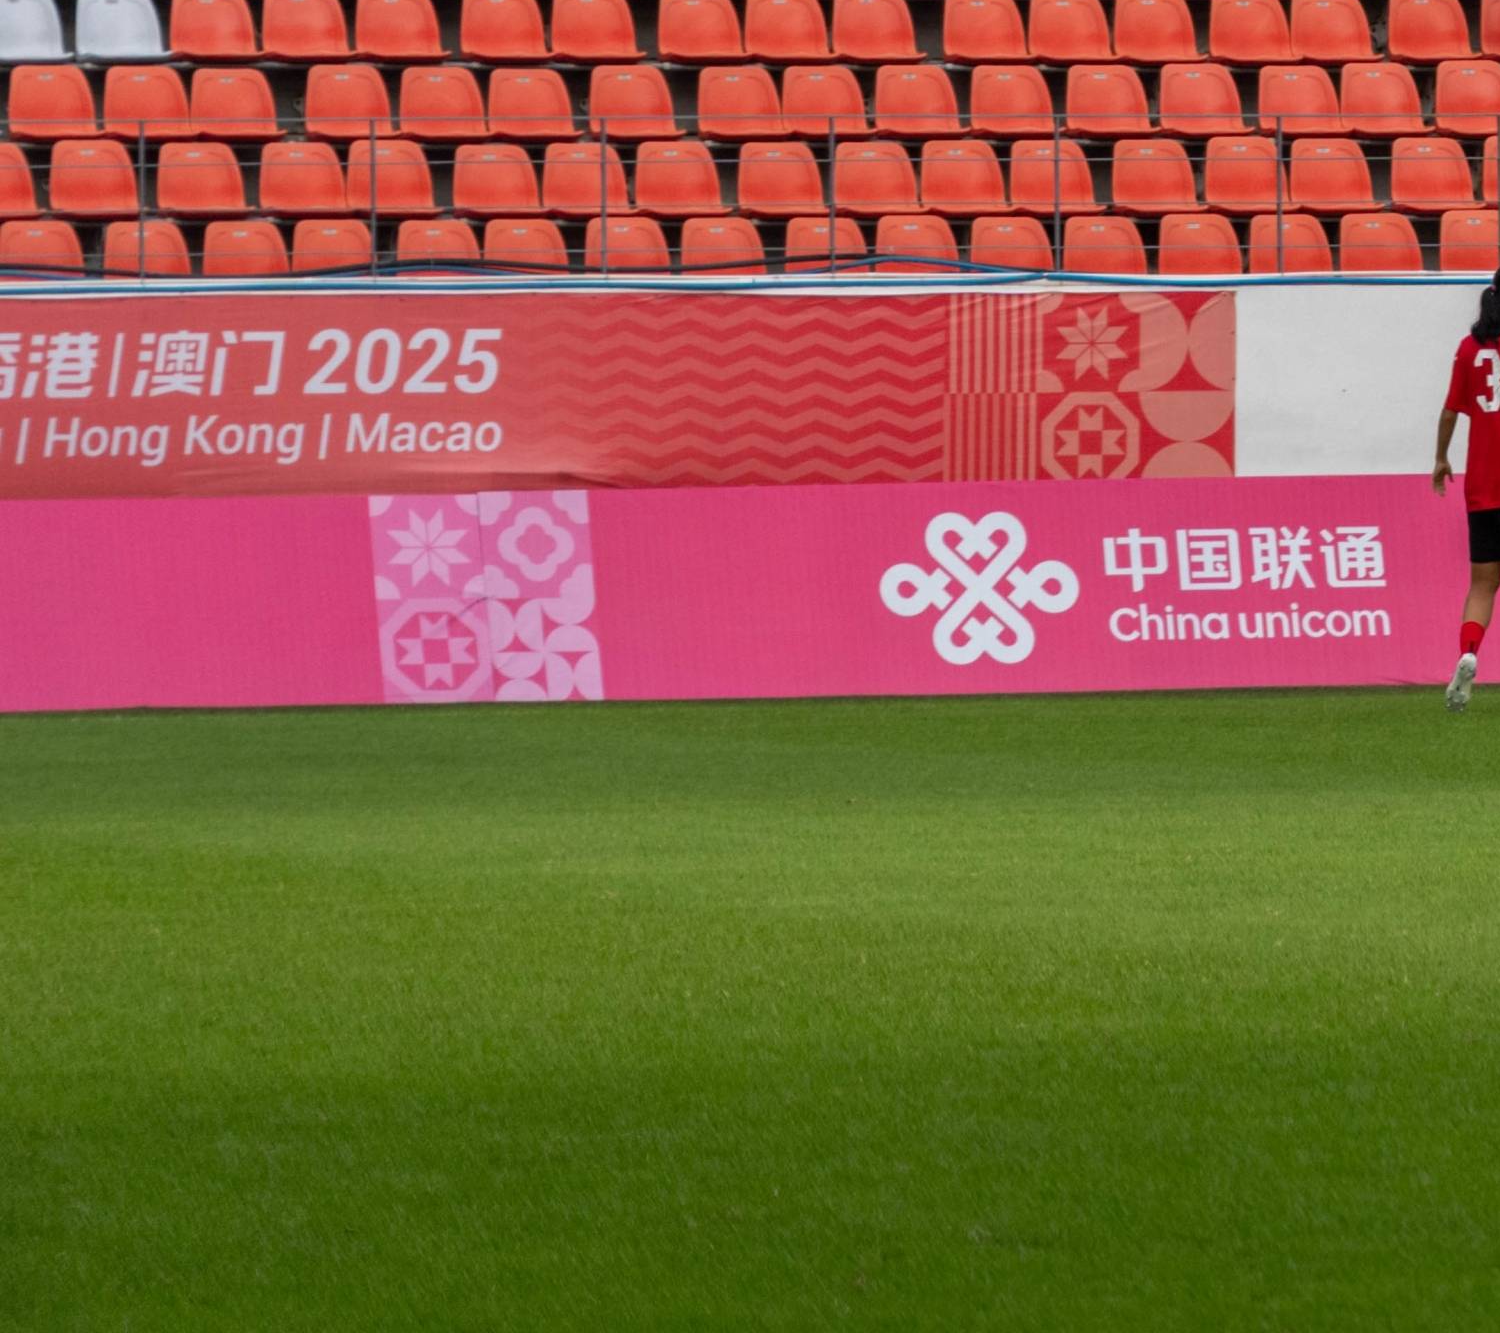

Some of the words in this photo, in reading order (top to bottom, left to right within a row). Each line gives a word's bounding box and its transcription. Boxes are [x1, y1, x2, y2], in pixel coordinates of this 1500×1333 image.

[304, 328, 503, 396] 2025
[44, 417, 169, 466] Hong
[184, 414, 304, 464] Kong
[347, 413, 502, 453] Macao
[1103, 526, 1388, 593] 中国联通
[1108, 603, 1230, 643] China
[1239, 605, 1391, 641] unicom
